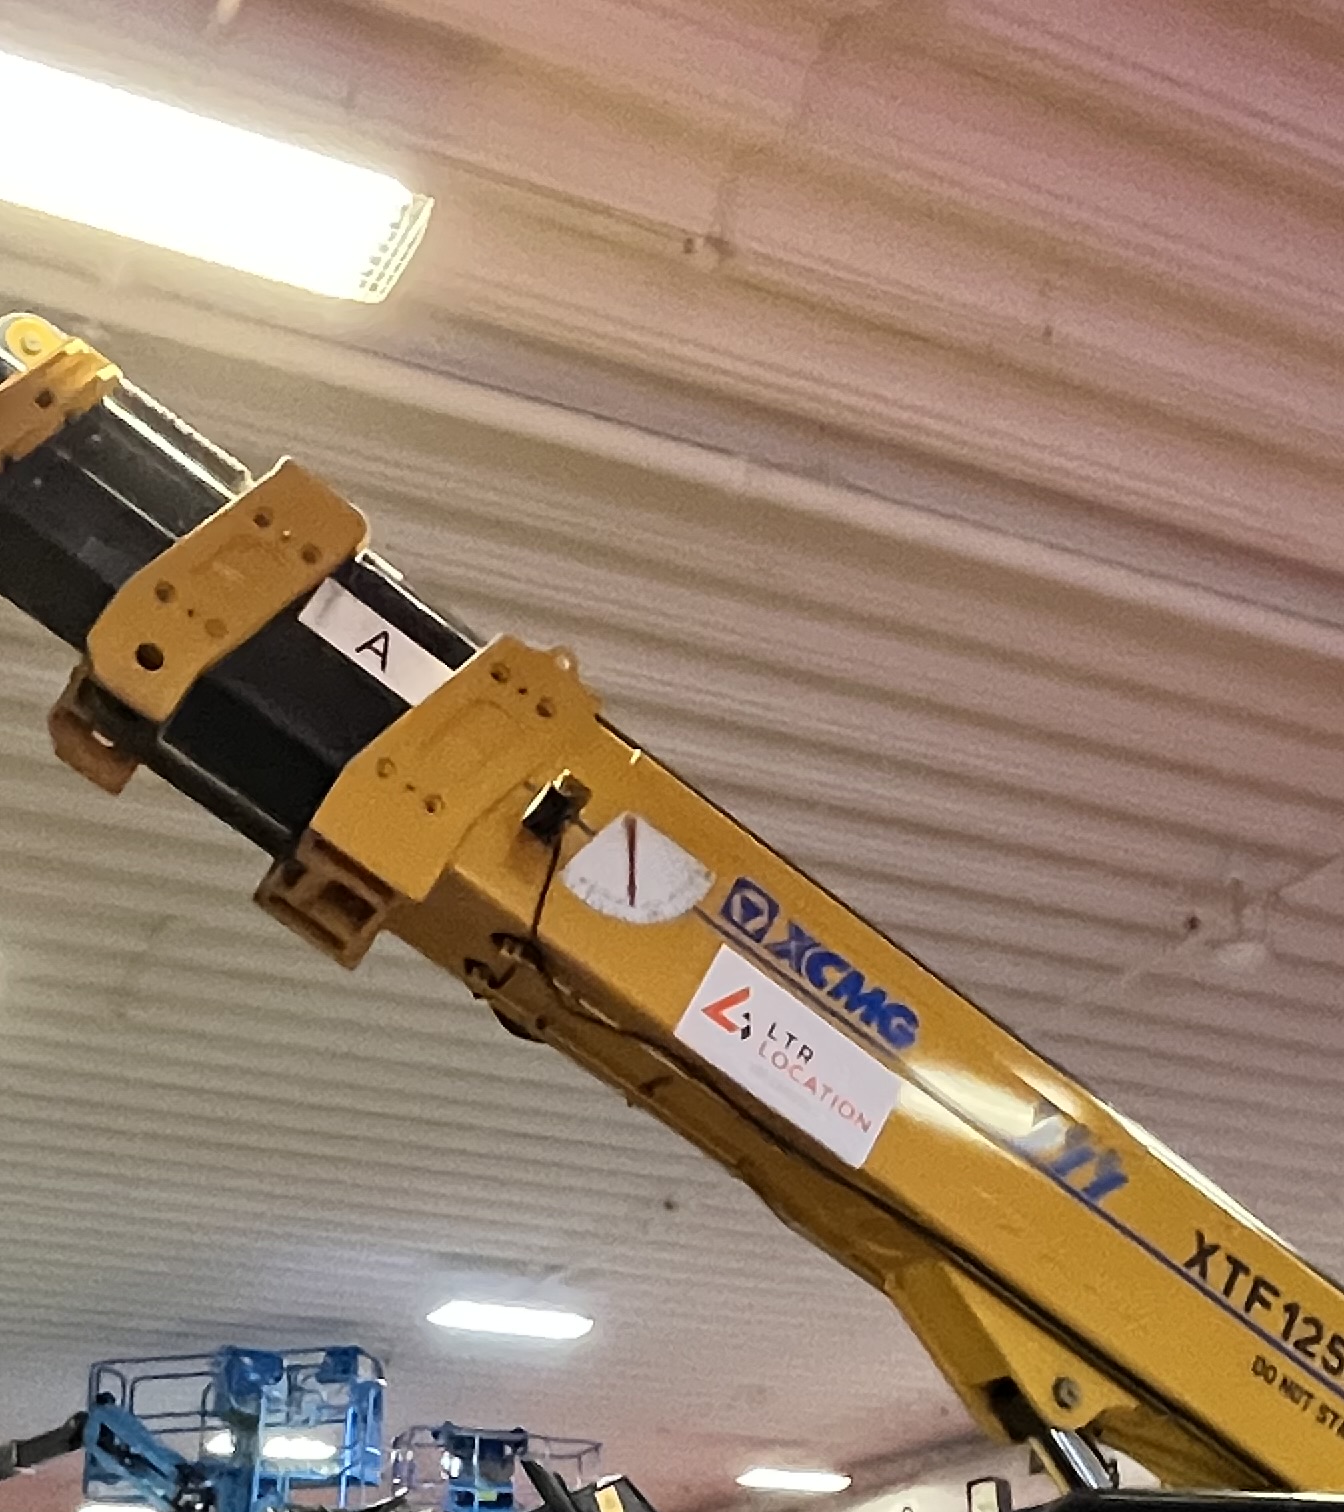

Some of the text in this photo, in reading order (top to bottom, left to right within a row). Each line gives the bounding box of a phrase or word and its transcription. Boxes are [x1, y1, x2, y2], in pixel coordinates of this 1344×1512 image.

[356, 629, 391, 673] A
[763, 918, 920, 1050] XCMG
[767, 1022, 814, 1064] LTR
[759, 1040, 873, 1134] LOCATION
[1251, 1354, 1278, 1385] DO
[1279, 1376, 1316, 1412] NOT
